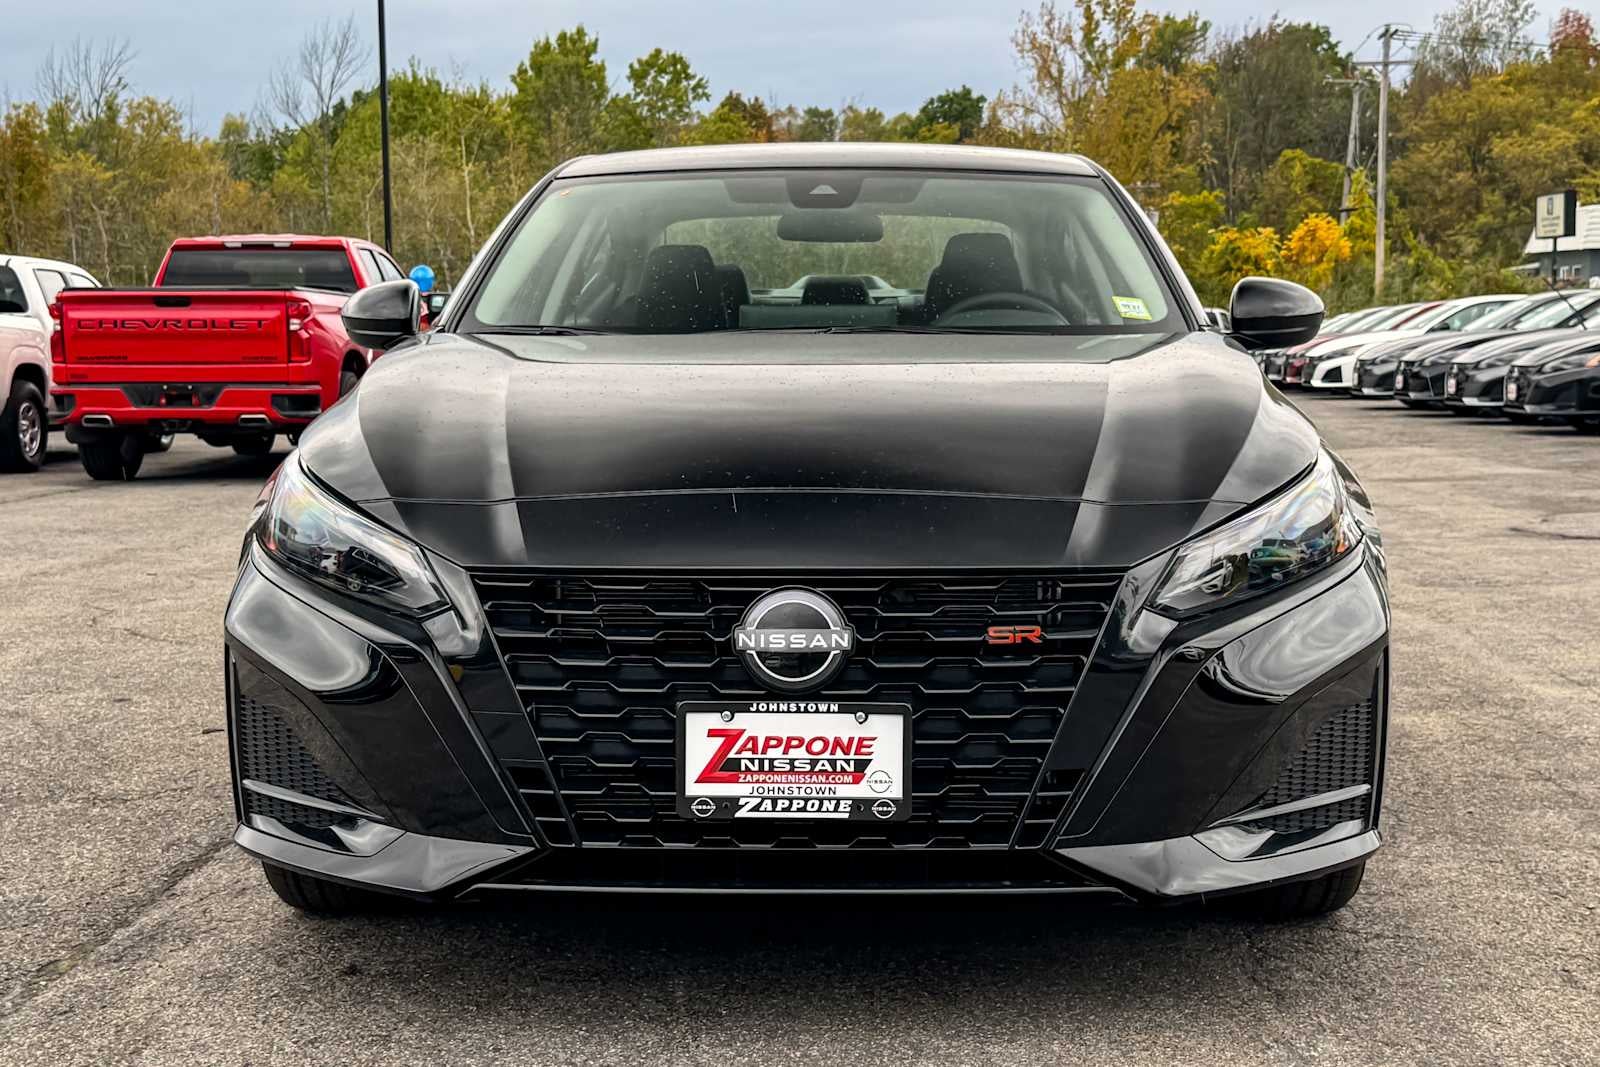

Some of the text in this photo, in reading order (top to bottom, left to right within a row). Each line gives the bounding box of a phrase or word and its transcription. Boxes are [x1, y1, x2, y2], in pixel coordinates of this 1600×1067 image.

[77, 319, 271, 332] CHEVROLET
[738, 633, 849, 648] NISSAN
[988, 625, 1042, 644] SR
[749, 702, 839, 712] JOHNSTOWN
[694, 728, 878, 783] ZAPPONE
[740, 759, 855, 772] NISSAN
[738, 773, 853, 783] ZAPPONENISSAN.COM
[749, 786, 837, 795] JOHNSTOWN
[734, 797, 853, 818] ZAPPONE
